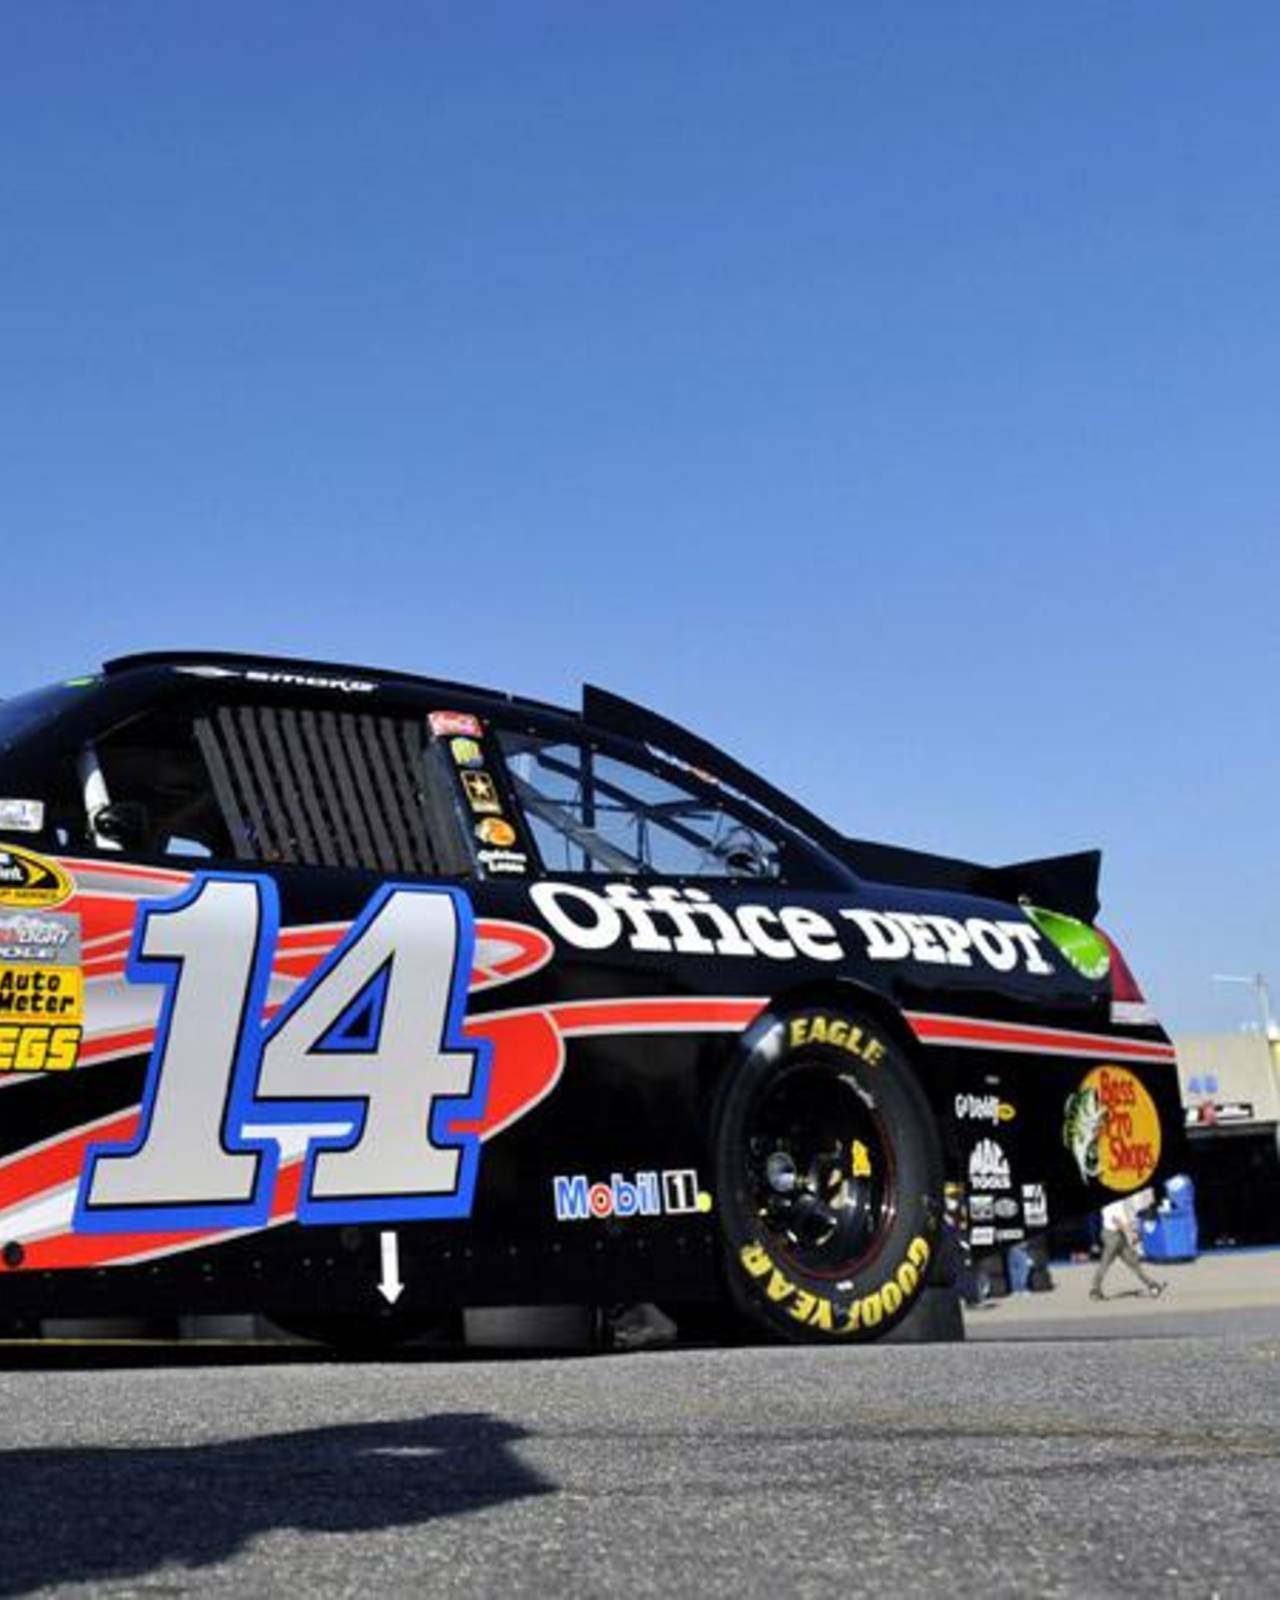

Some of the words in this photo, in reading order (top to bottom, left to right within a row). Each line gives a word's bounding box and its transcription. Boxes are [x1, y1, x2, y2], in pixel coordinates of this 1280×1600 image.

[530, 881, 845, 962] Office
[839, 908, 1056, 975] DEPOT
[74, 872, 489, 1228] 14
[788, 1016, 888, 1067] EAGLE
[553, 1173, 662, 1220] Mobil
[739, 1236, 932, 1333] GOODYEAR
